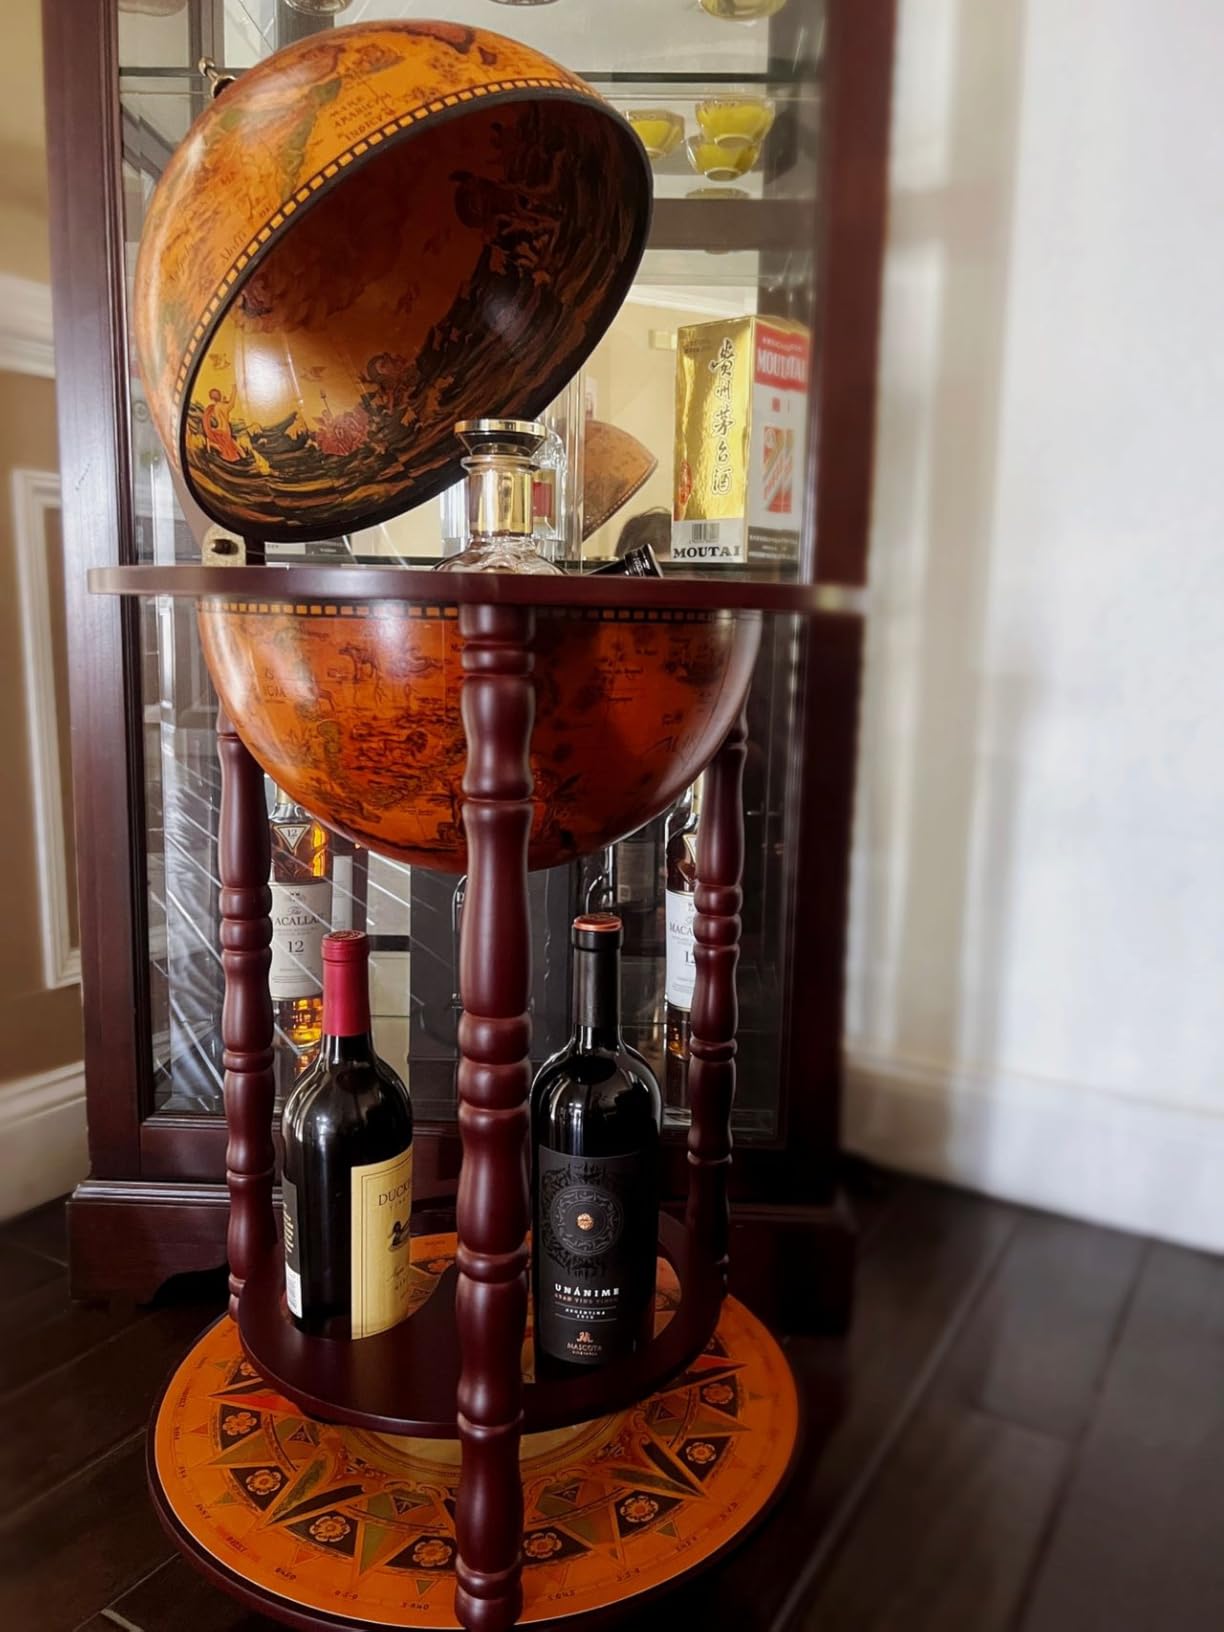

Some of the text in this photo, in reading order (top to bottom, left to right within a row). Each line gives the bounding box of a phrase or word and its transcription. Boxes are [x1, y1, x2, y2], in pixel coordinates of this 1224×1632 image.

[673, 545, 741, 559] MOUTAI
[288, 940, 304, 953] 12
[554, 1283, 620, 1297] UNÁNIME
[566, 1342, 603, 1352] MASCOTA
